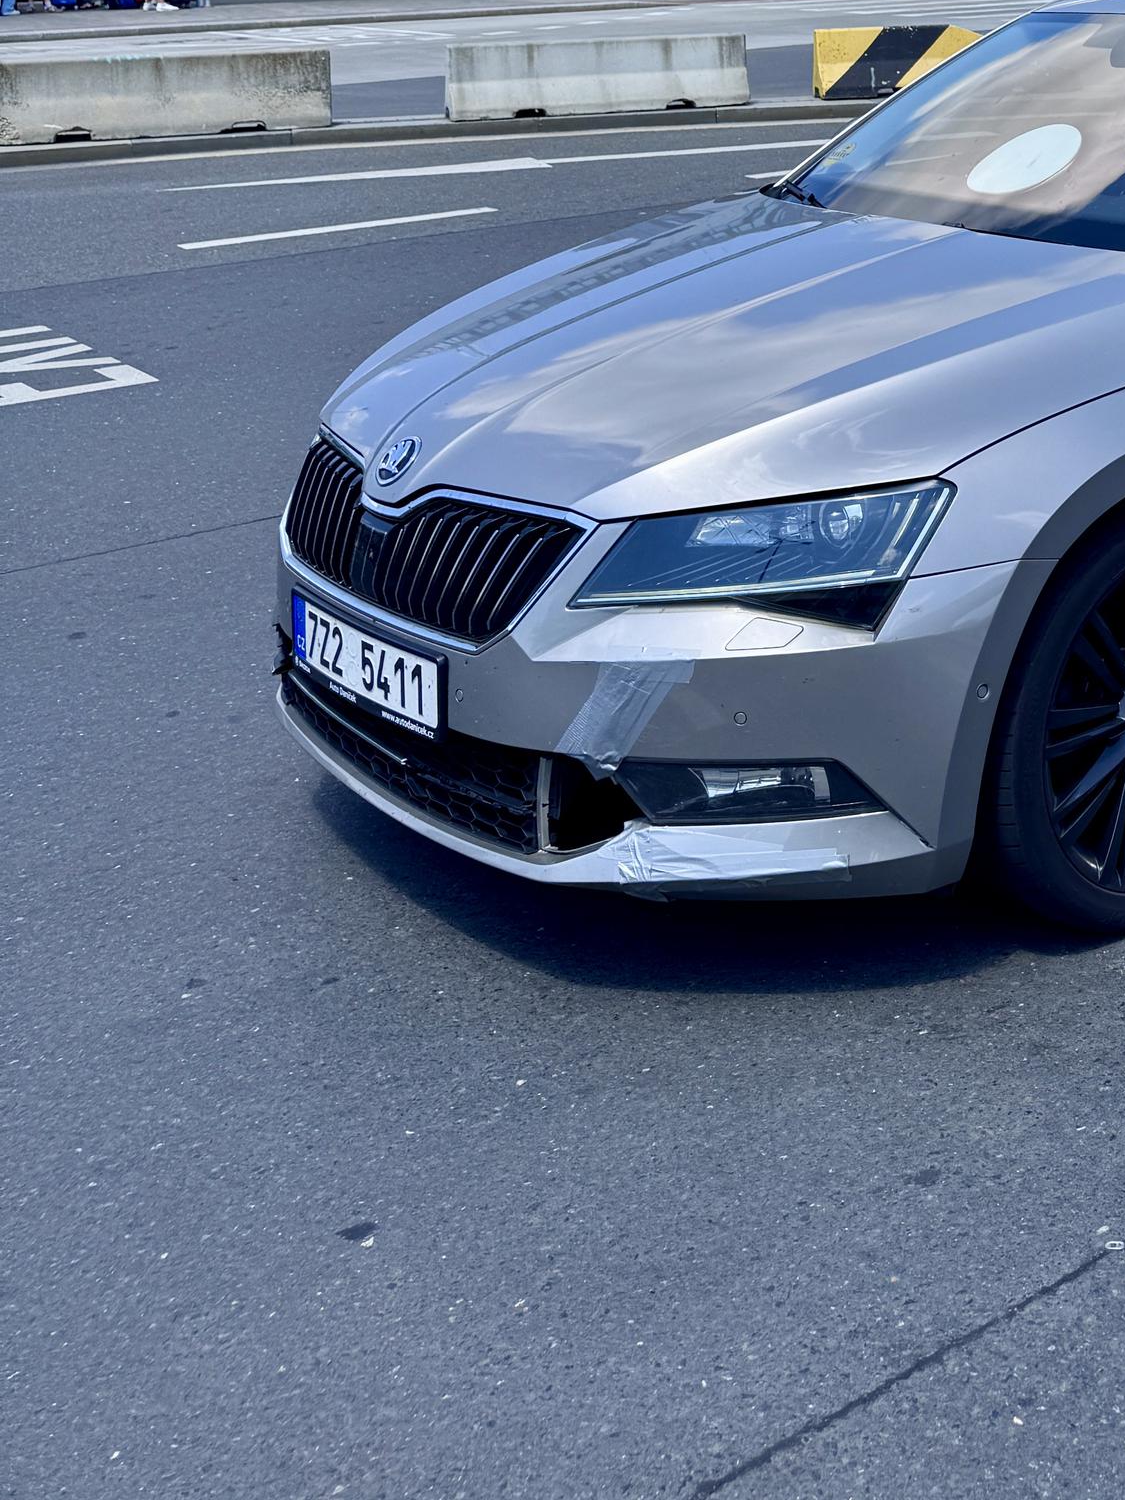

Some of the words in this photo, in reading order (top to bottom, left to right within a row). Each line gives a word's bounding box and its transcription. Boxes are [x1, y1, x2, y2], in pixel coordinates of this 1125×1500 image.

[297, 634, 306, 651] CZ
[308, 610, 344, 678] 7Z2
[361, 639, 424, 717] 5411
